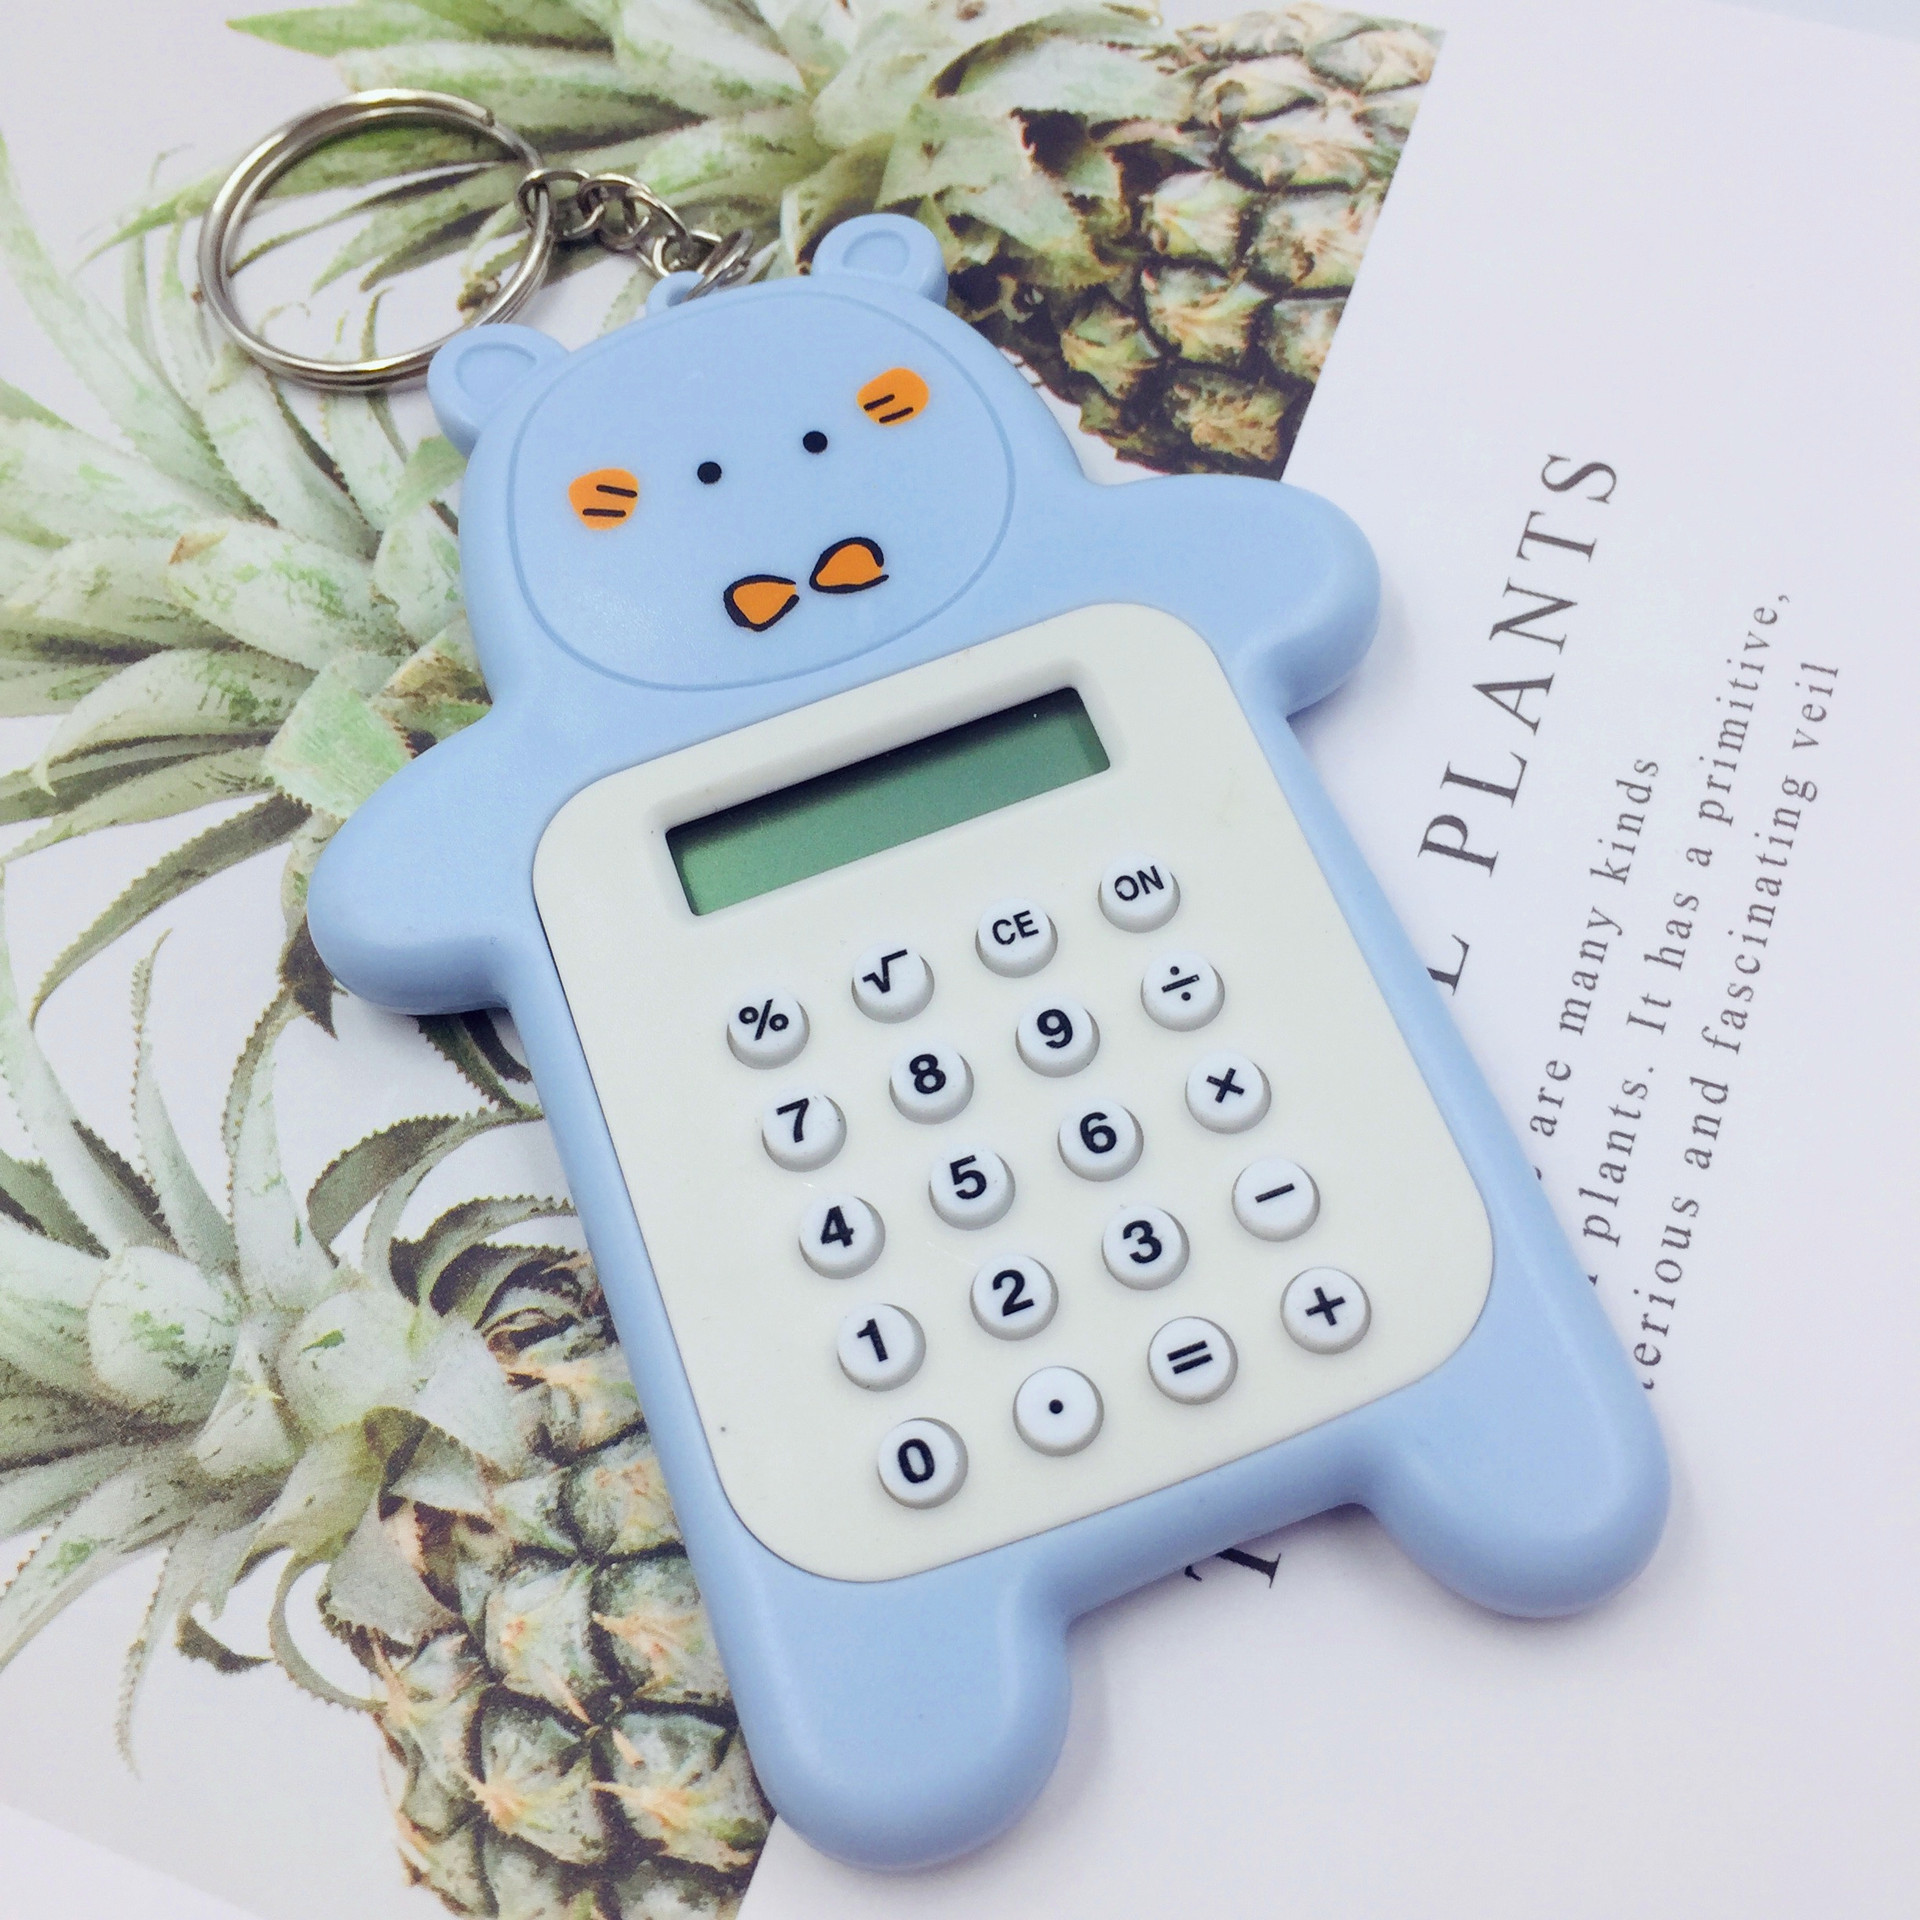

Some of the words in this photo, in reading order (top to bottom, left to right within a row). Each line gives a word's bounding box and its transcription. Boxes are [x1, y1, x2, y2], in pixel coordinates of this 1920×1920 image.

[1417, 453, 1617, 877] PLANTS
[1699, 595, 1790, 827] primitive,
[1793, 662, 1839, 749] veil
[1590, 759, 1659, 885] kinds
[1686, 847, 1713, 867] a
[991, 909, 1039, 946] CE
[1114, 865, 1165, 902] ON
[1644, 892, 1700, 971] has
[1702, 775, 1818, 1055] fascinating
[1559, 906, 1623, 1036] many
[1627, 992, 1672, 1035] It
[776, 1097, 810, 1143] 7
[909, 1053, 947, 1095] 8
[1036, 1008, 1074, 1050] 9
[1530, 1060, 1572, 1137] are
[1685, 1076, 1729, 1170] and
[820, 1205, 854, 1248] 4
[949, 1154, 987, 1200] 5
[1079, 1111, 1117, 1154] 6
[1578, 1067, 1654, 1248] plants.
[856, 1318, 889, 1363] 1
[992, 1269, 1035, 1317] 2
[1122, 1220, 1163, 1265] 3
[897, 1438, 935, 1484] 0
